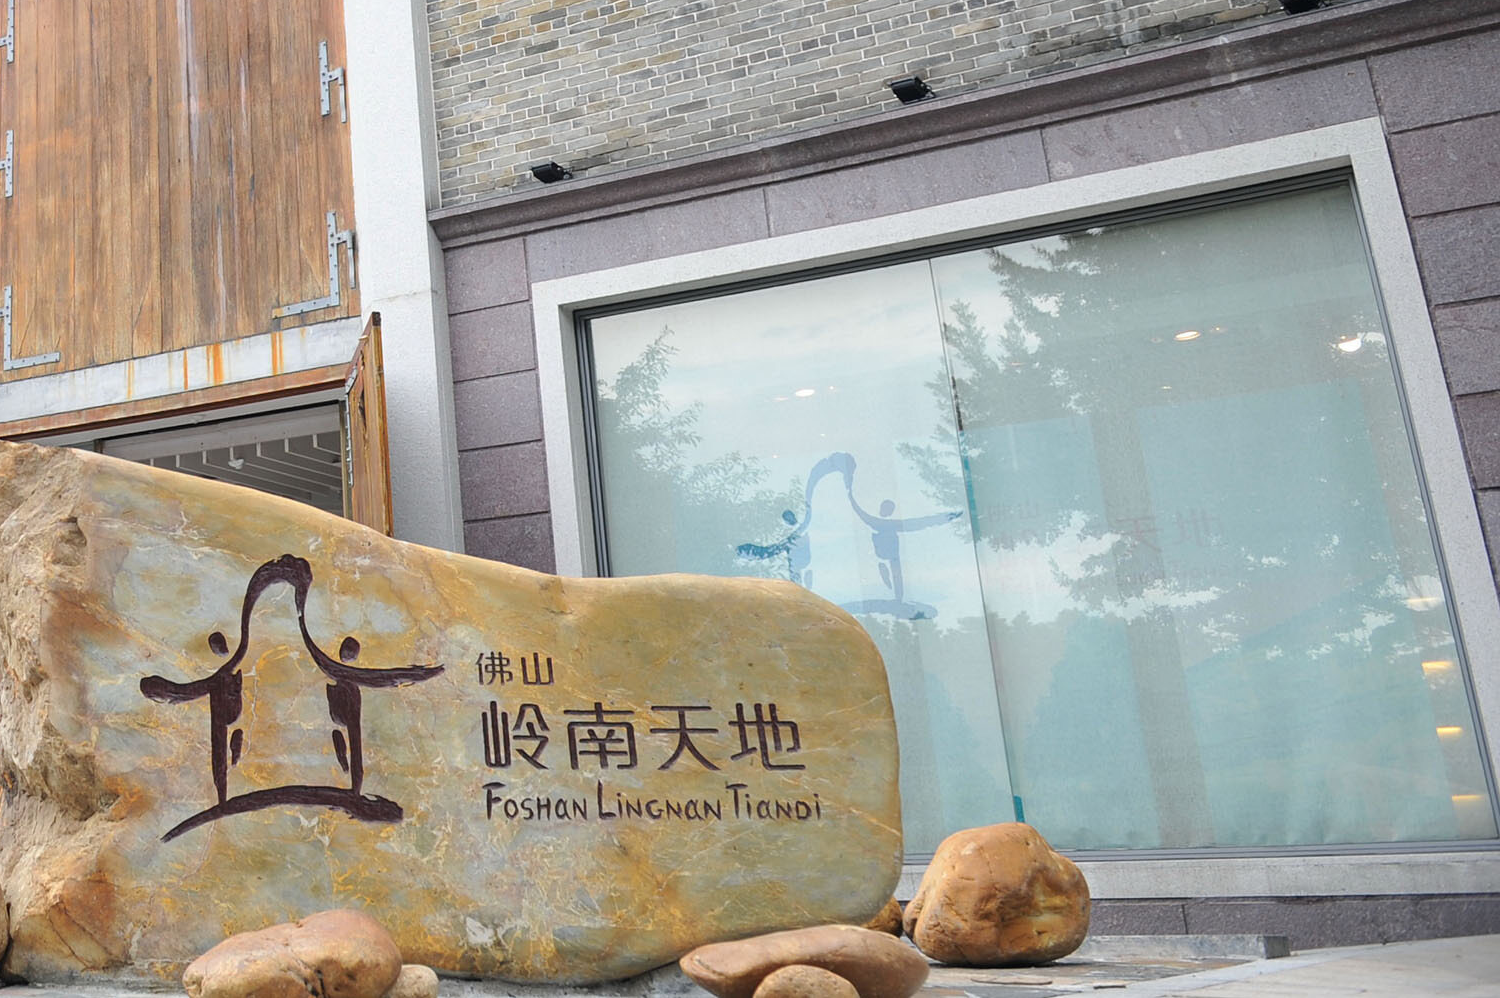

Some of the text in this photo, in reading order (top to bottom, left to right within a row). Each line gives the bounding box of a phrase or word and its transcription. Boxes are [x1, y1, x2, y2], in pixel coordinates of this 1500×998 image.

[475, 651, 555, 686] 佛山
[481, 700, 806, 772] 岭南天地
